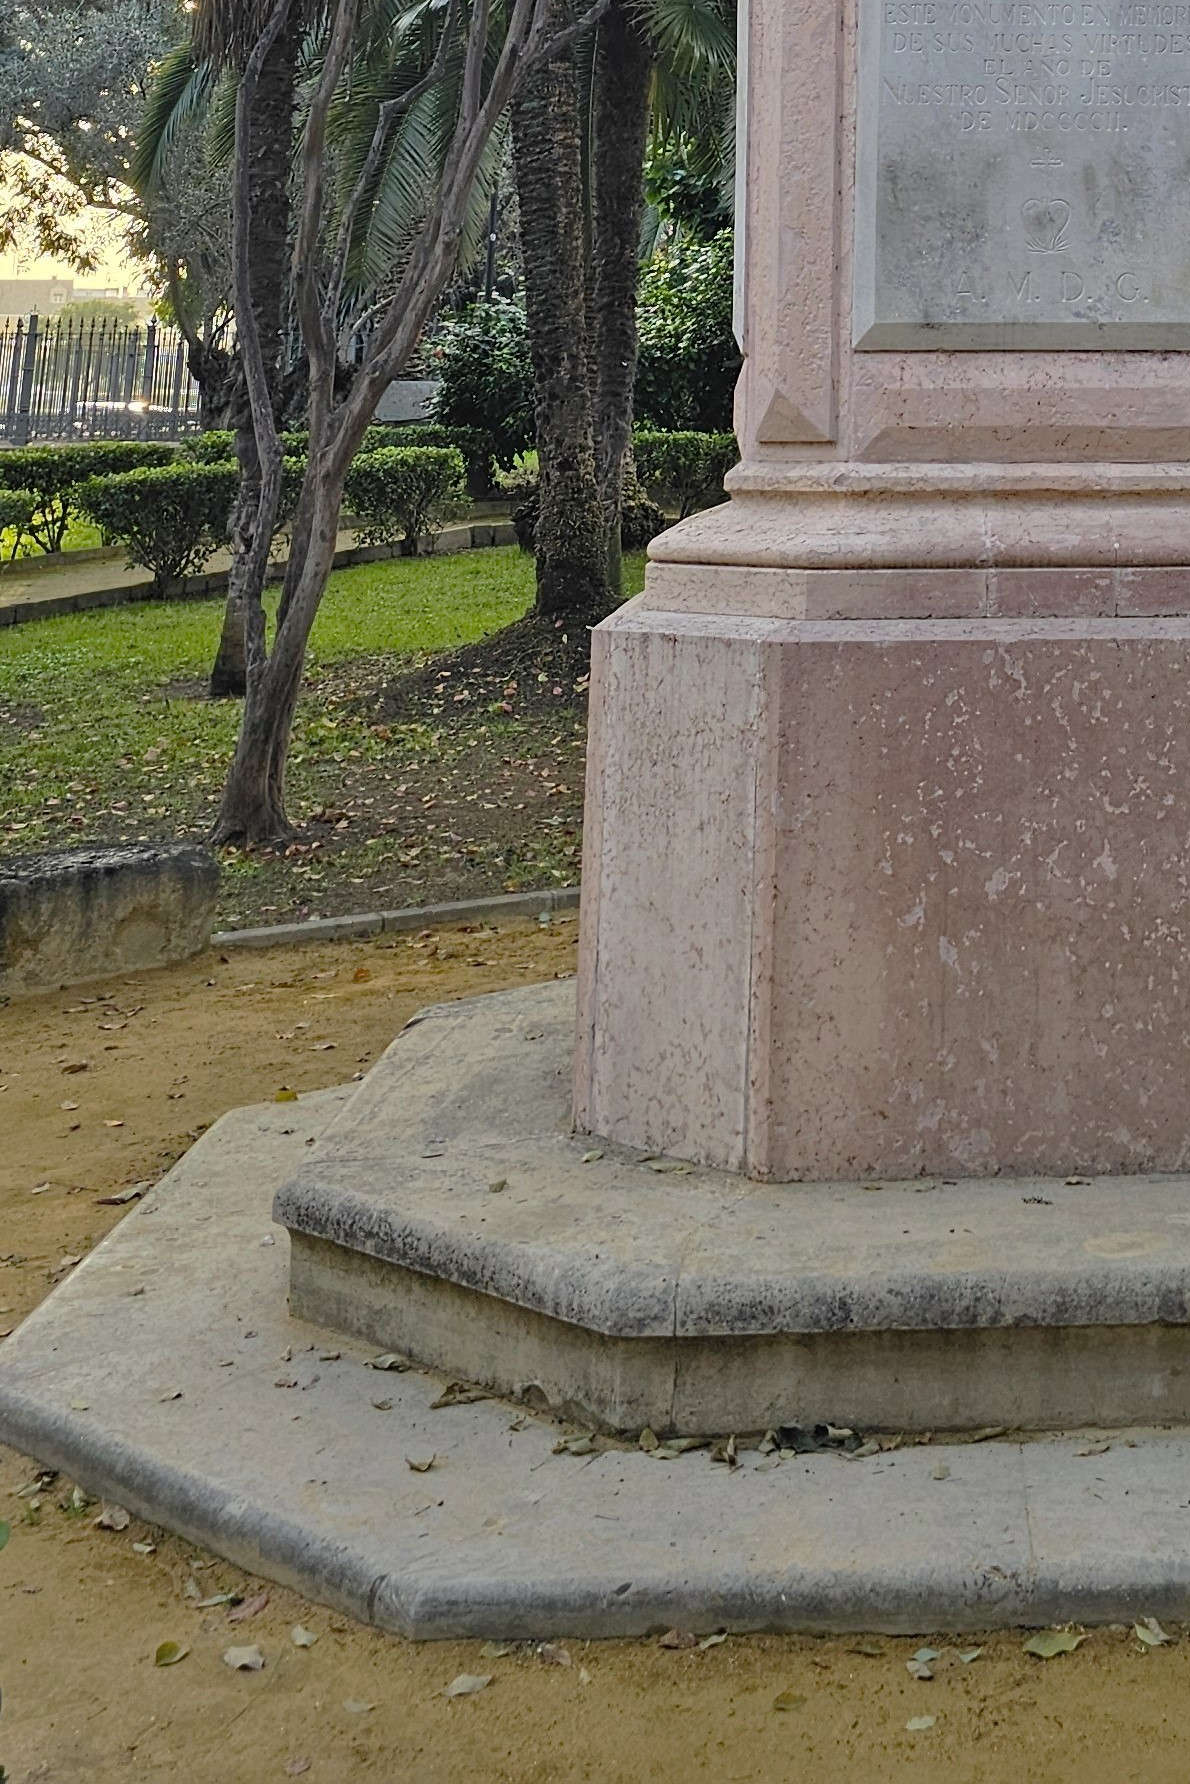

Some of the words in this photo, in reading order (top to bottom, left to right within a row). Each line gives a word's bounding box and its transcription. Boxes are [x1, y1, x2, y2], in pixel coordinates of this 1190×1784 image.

[884, 2, 937, 26] ESTE
[945, 2, 1074, 27] MONUMENTO
[1080, 3, 1111, 27] EN
[893, 31, 924, 54] DE
[932, 31, 974, 54] SUS
[983, 32, 1074, 55] MUCHAS
[984, 58, 1015, 77] EL
[1079, 59, 1112, 78] DE
[882, 75, 988, 106] NUESTRO
[960, 110, 994, 132] DE
